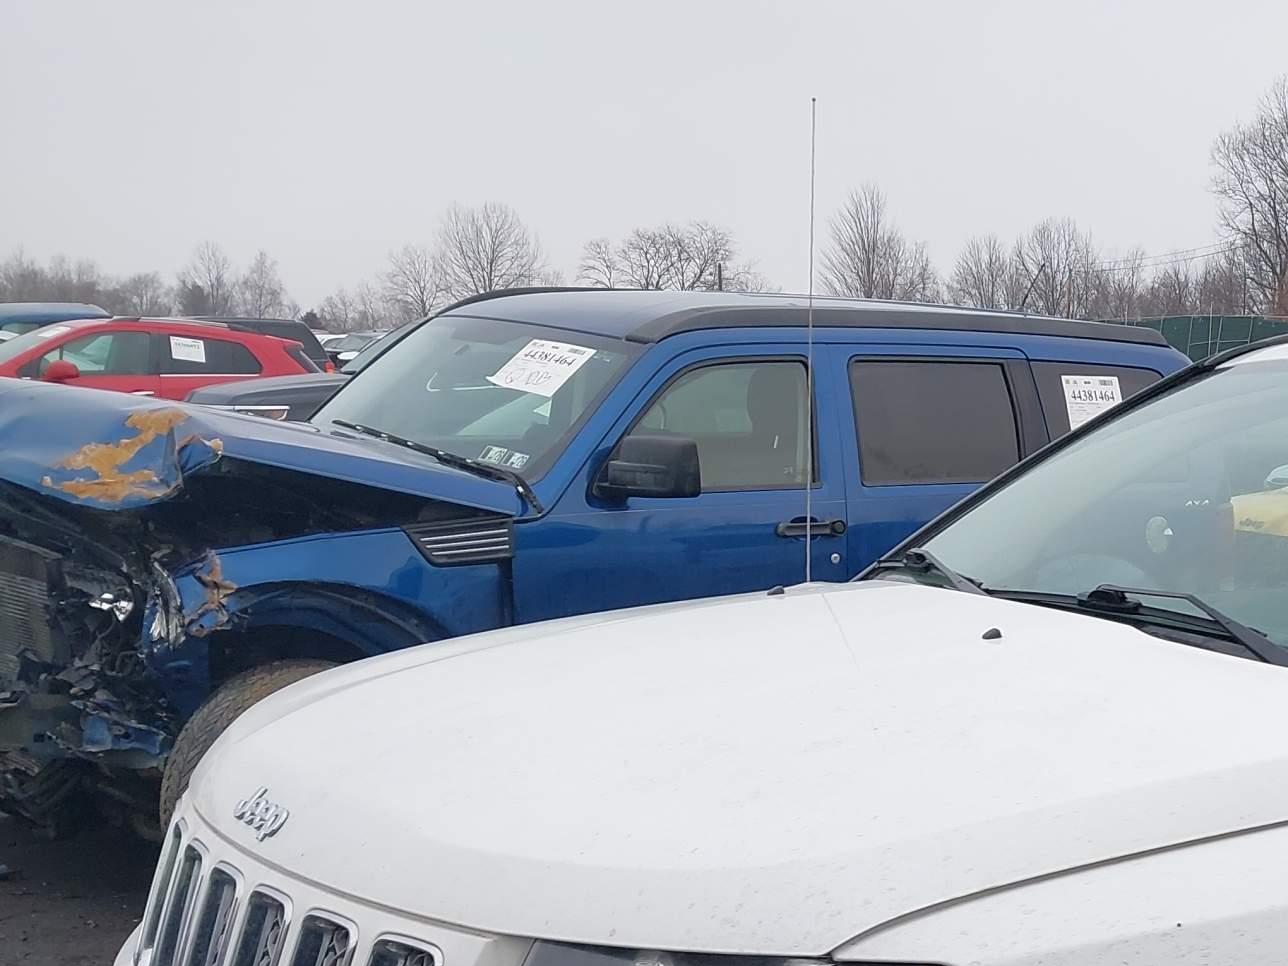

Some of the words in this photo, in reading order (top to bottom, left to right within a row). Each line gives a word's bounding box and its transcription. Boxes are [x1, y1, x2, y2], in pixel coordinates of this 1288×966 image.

[524, 350, 577, 366] 44381464
[1071, 389, 1115, 402] 44381464
[233, 787, 290, 842] Jeep
